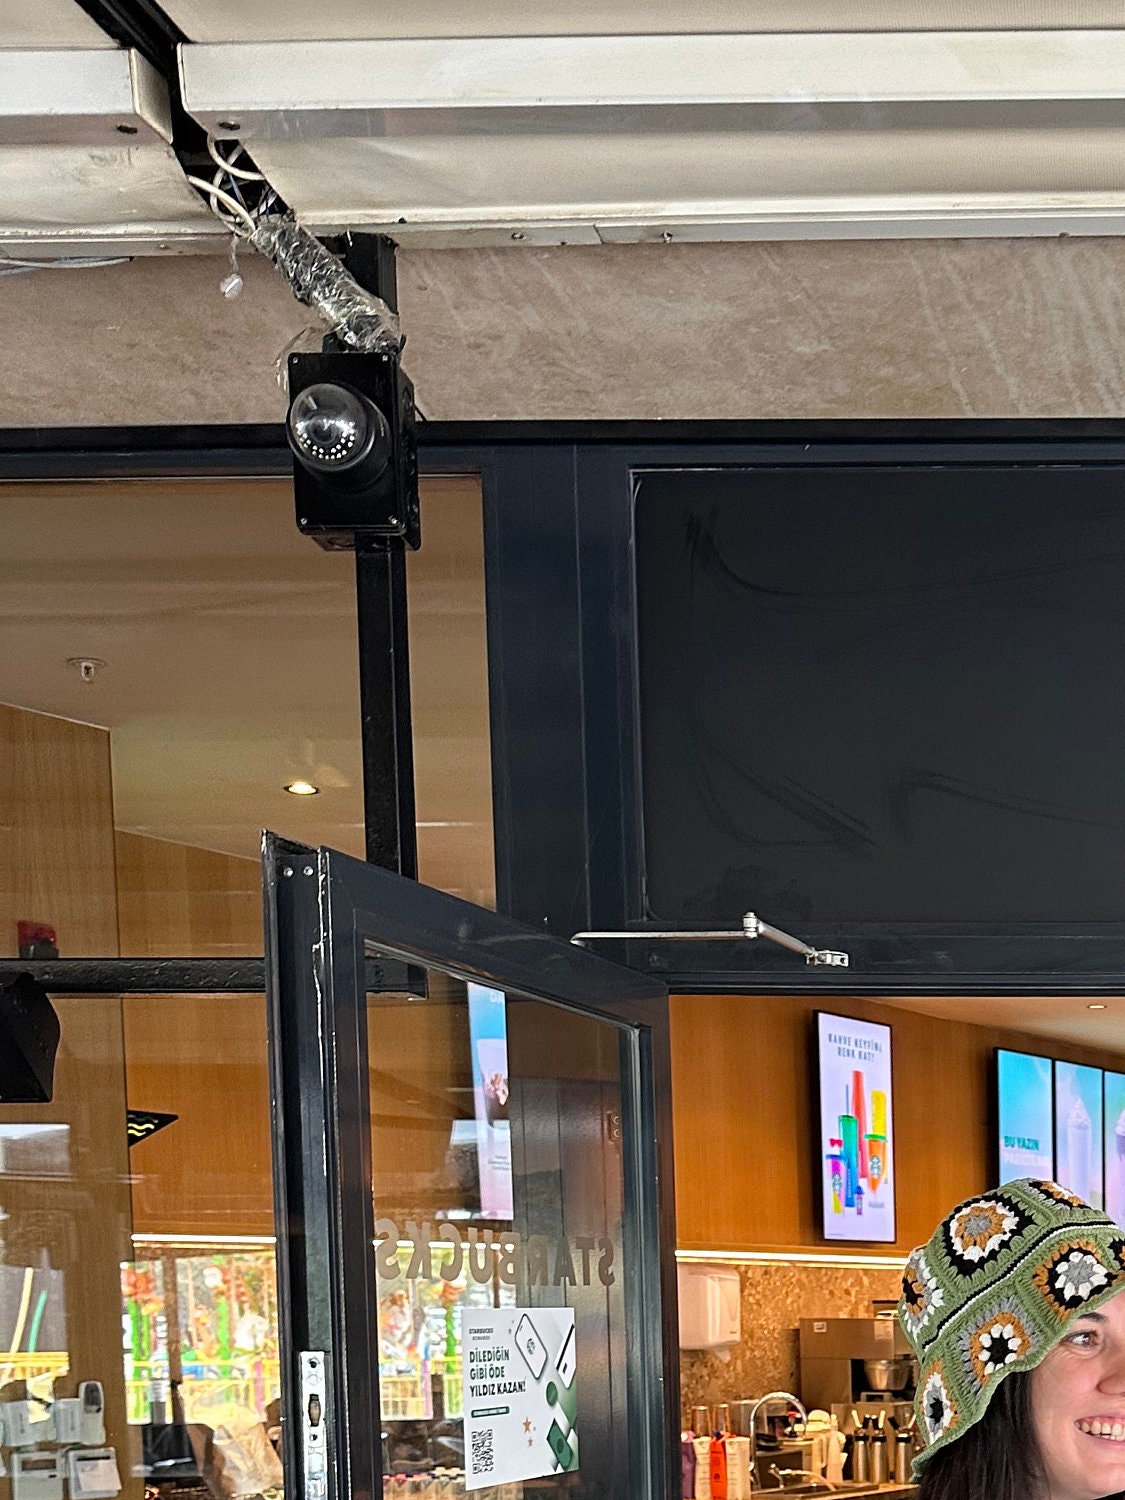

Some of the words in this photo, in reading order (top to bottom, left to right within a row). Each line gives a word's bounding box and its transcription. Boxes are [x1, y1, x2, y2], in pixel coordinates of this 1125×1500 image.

[469, 1346, 510, 1363] DİLEDİĞİN
[470, 1364, 488, 1380] GİBİ
[488, 1363, 505, 1378] ÖDE
[469, 1383, 496, 1397] YILDIZ
[496, 1380, 527, 1395] KAZAN!
